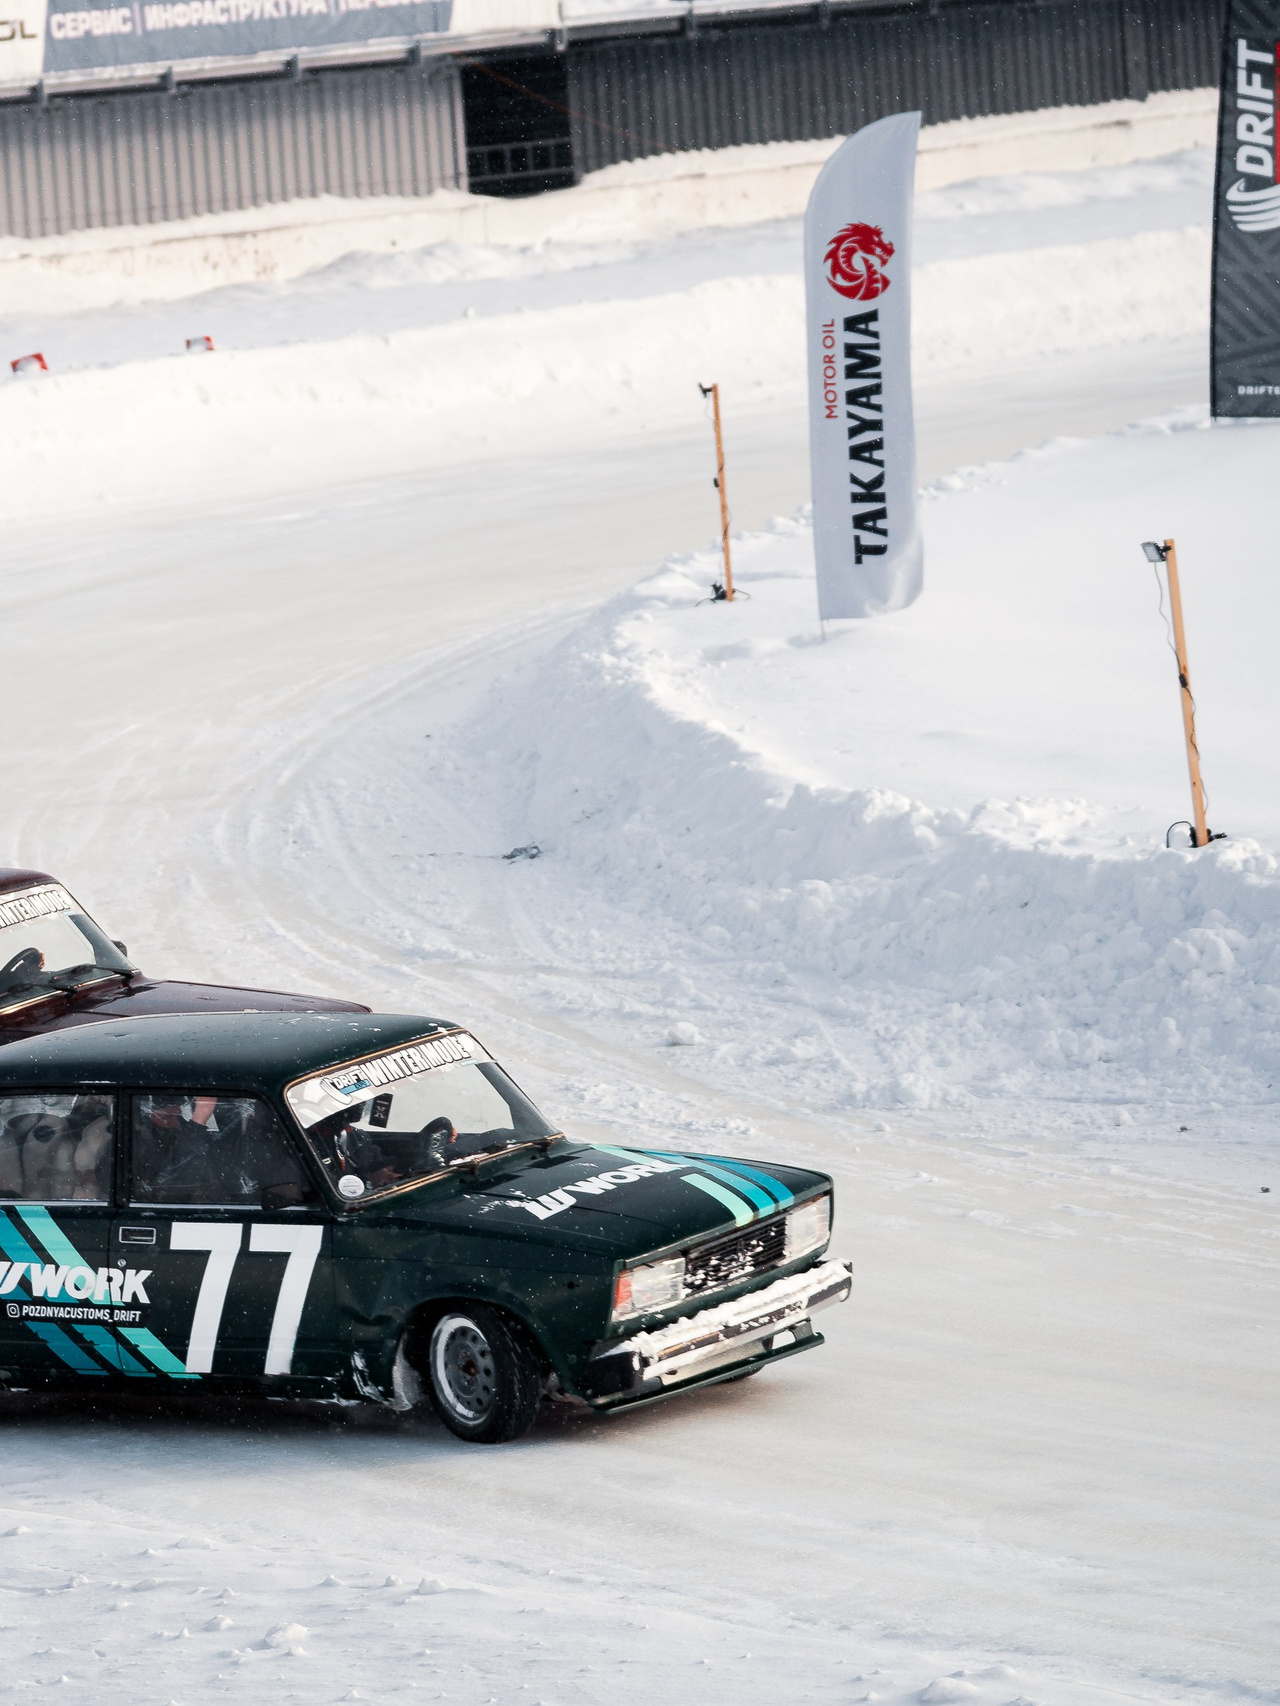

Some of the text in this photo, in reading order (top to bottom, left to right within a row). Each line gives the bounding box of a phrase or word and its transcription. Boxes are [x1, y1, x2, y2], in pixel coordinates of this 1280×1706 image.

[49, 7, 132, 40] СЕРВИС
[1236, 38, 1274, 178] DRIFT
[822, 318, 839, 419] MOTOR OIL
[843, 308, 888, 564] TAKAYAMA
[333, 1068, 365, 1090] DRIFT
[22, 1305, 141, 1322] POZDNYACUSTOMS_DRIFT
[30, 1263, 153, 1304] WORK
[170, 1222, 324, 1375] 77
